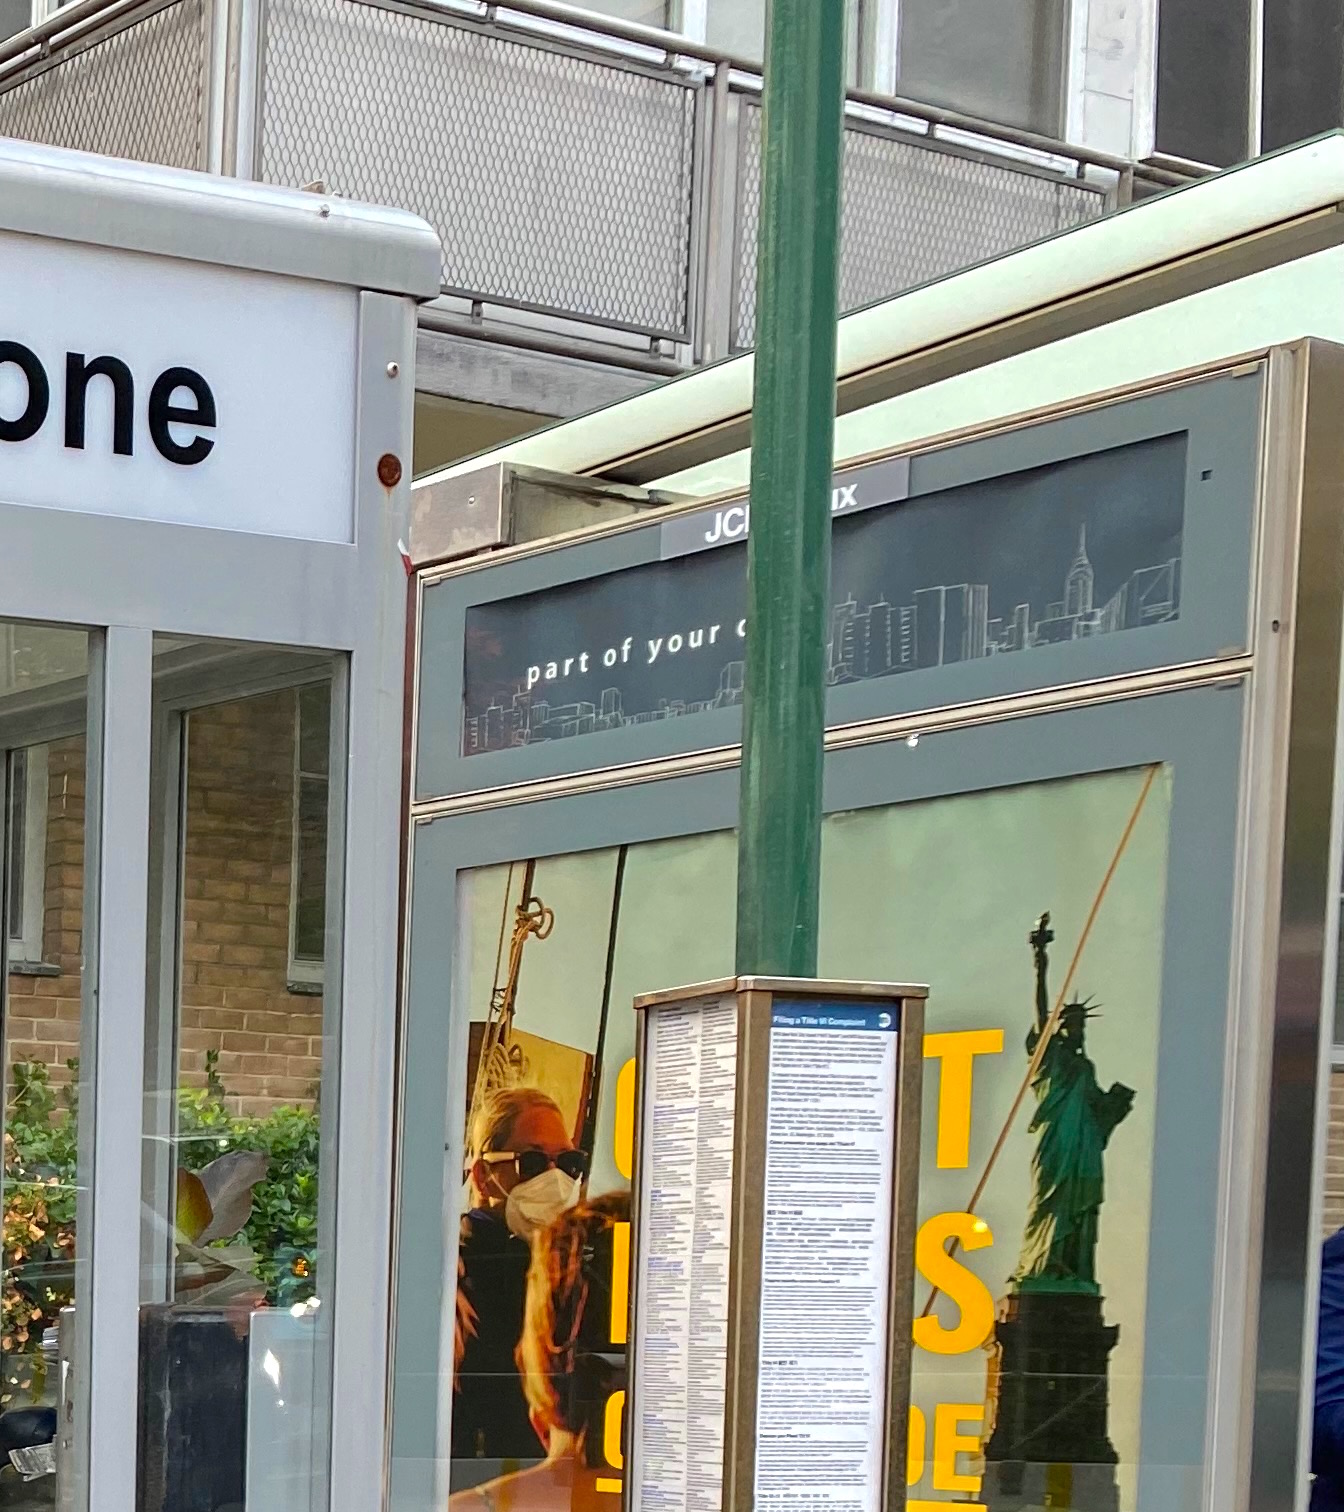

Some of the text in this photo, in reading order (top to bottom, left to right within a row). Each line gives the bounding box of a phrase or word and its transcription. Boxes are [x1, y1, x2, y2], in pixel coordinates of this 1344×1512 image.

[527, 652, 590, 690] part
[603, 636, 633, 667] of
[648, 624, 721, 664] your
